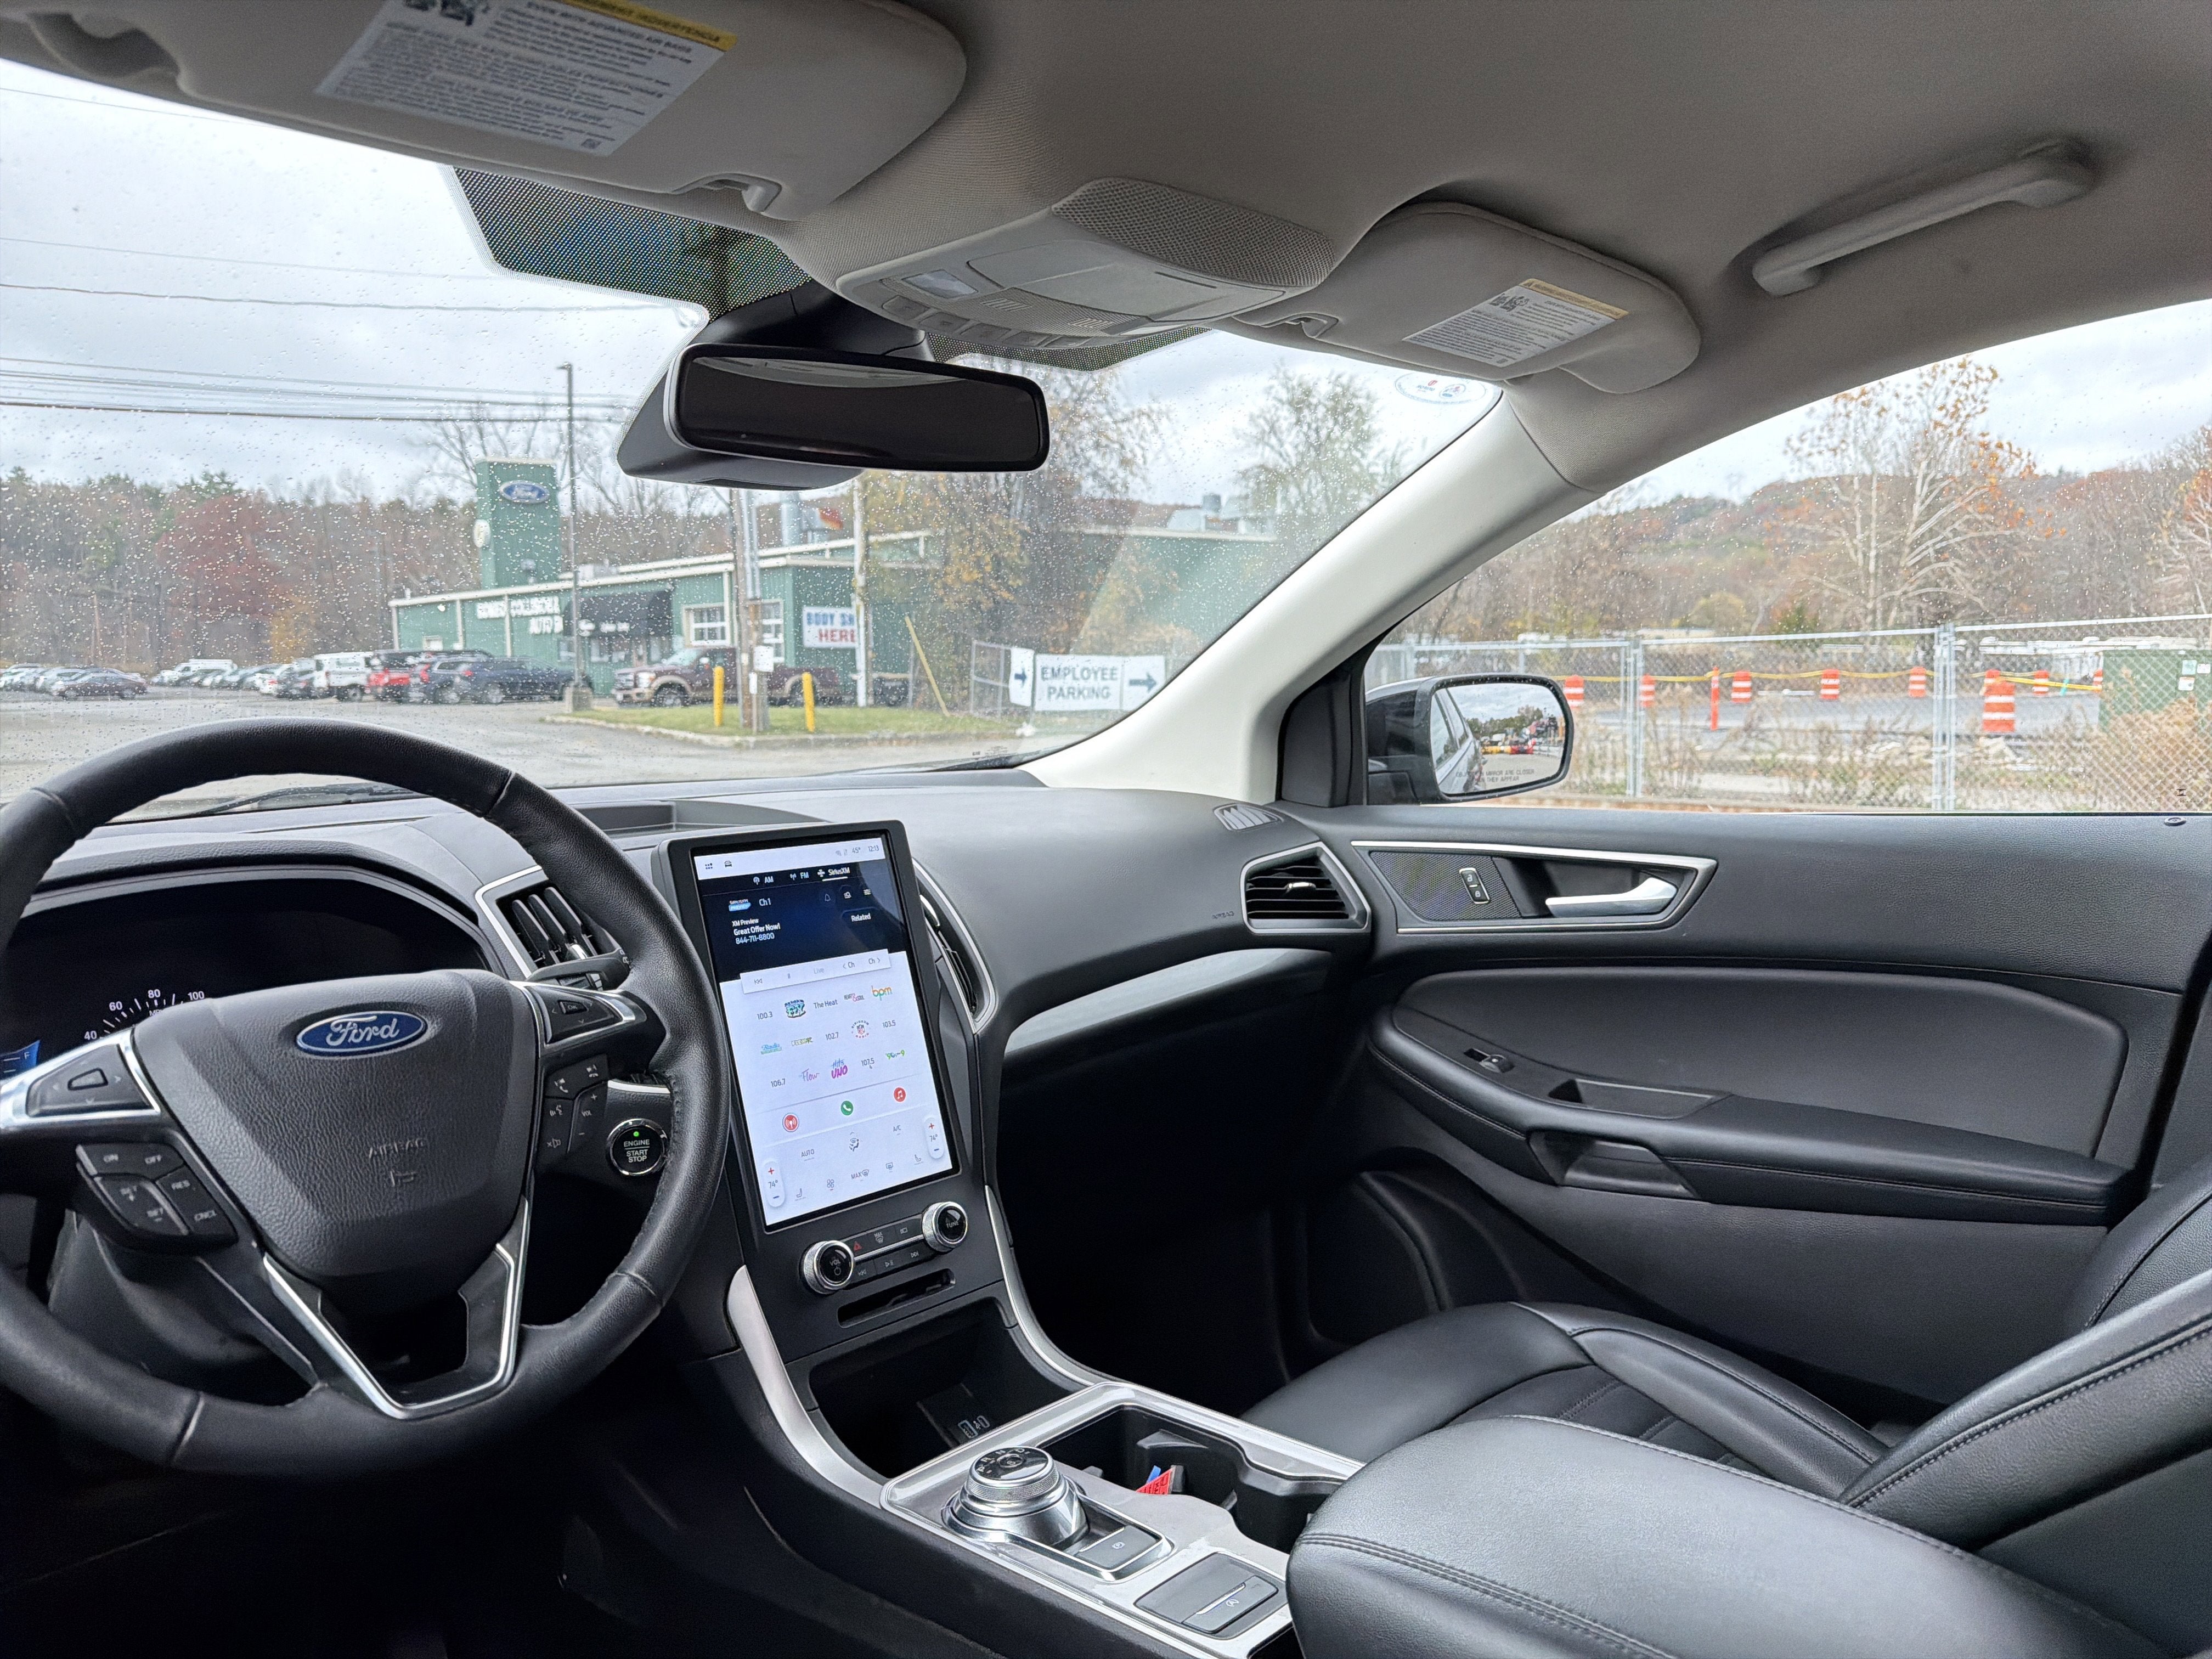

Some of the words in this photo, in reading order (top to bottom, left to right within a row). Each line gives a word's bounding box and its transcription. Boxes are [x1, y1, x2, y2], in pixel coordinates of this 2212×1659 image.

[1041, 667, 1118, 681] EMPLOYEE
[1047, 686, 1111, 701] PARKING
[828, 867, 850, 876] SiriusXM
[851, 913, 871, 922] Related
[733, 927, 750, 936] Great
[751, 925, 765, 934] Offer
[765, 923, 780, 932] Now!
[735, 933, 775, 945] 844-711-8800
[148, 989, 161, 998] 80
[187, 990, 205, 1000] 100
[871, 985, 893, 1001] bpm
[109, 1001, 123, 1011] 60
[825, 999, 838, 1007] Heat
[757, 1011, 773, 1020] 100.3
[882, 1020, 896, 1029] 103.5
[84, 1030, 97, 1040] 40
[326, 1015, 400, 1046] Ford
[825, 1032, 839, 1041] 102.7
[24, 1052, 30, 1060] F
[861, 1058, 875, 1066] 107.5
[801, 1069, 820, 1081] Flow
[831, 1065, 848, 1079] UNO
[771, 1078, 786, 1088] 106.7
[623, 1139, 650, 1147] ENGINE
[801, 1149, 815, 1158] AUTO
[946, 1221, 959, 1229] TUNE
[830, 1259, 840, 1267] VOL
